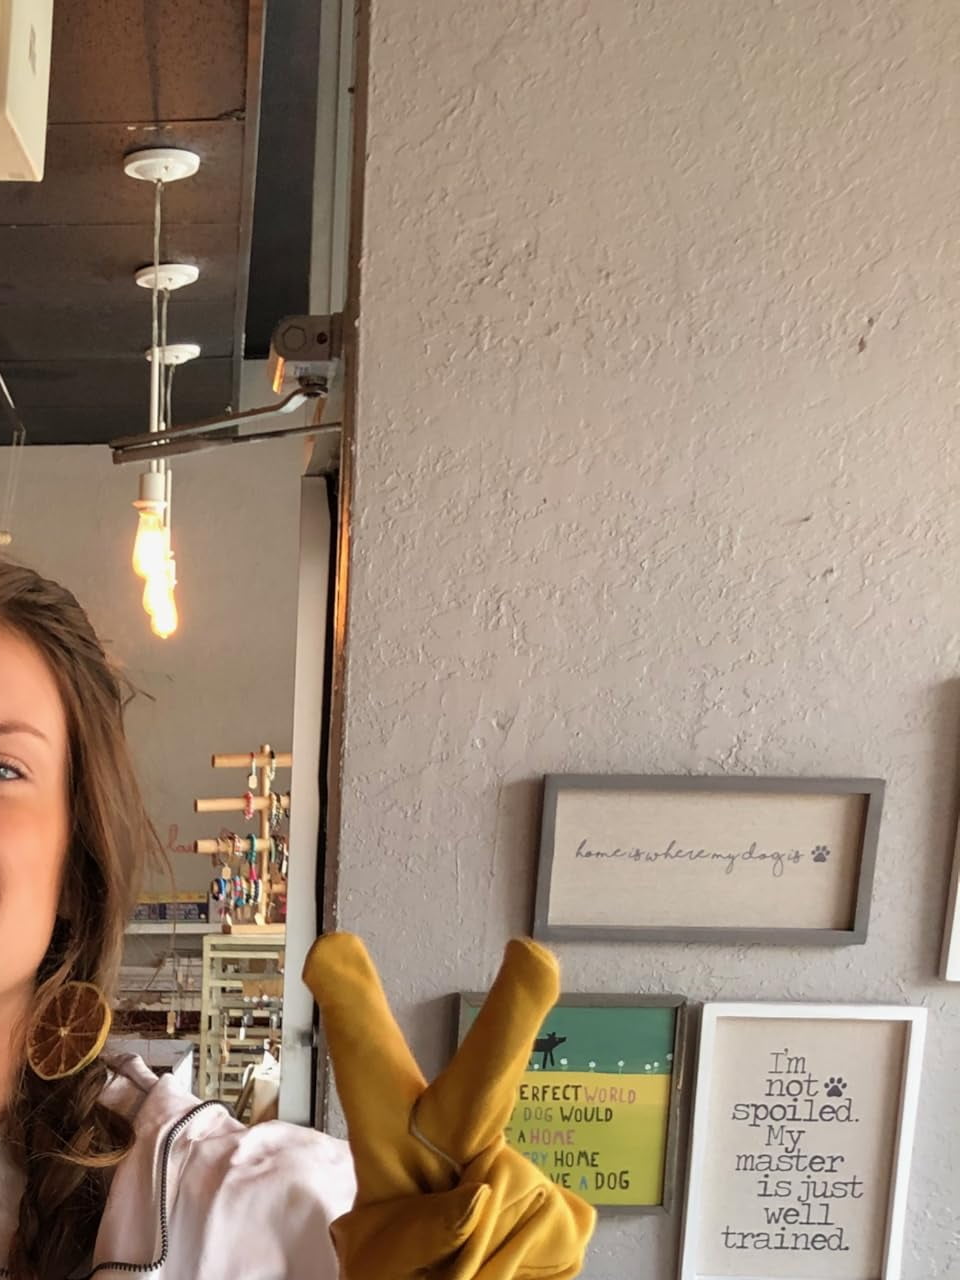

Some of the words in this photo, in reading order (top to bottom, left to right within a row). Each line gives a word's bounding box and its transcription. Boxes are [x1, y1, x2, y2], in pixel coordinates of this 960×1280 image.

[576, 840, 625, 859] home
[627, 848, 642, 862] is
[645, 840, 711, 862] where
[711, 849, 739, 875] my
[741, 842, 785, 877] dog
[787, 848, 804, 863] is
[768, 1048, 806, 1074] I'm
[519, 1084, 582, 1102] ERFECT
[583, 1086, 637, 1104] WORLD
[765, 1073, 819, 1097] not
[524, 1107, 553, 1122] DOG
[559, 1106, 613, 1123] WOULD
[732, 1097, 860, 1127] spoiled.
[517, 1129, 527, 1144] A
[529, 1128, 576, 1145] HOME
[765, 1125, 806, 1153] My
[554, 1150, 600, 1168] HOME
[735, 1148, 844, 1173] master
[550, 1173, 571, 1189] VE
[579, 1175, 589, 1190] A
[595, 1170, 630, 1190] DOG
[757, 1174, 792, 1197] is
[797, 1174, 864, 1202] just
[763, 1203, 835, 1226] well
[721, 1225, 850, 1251] trained.
